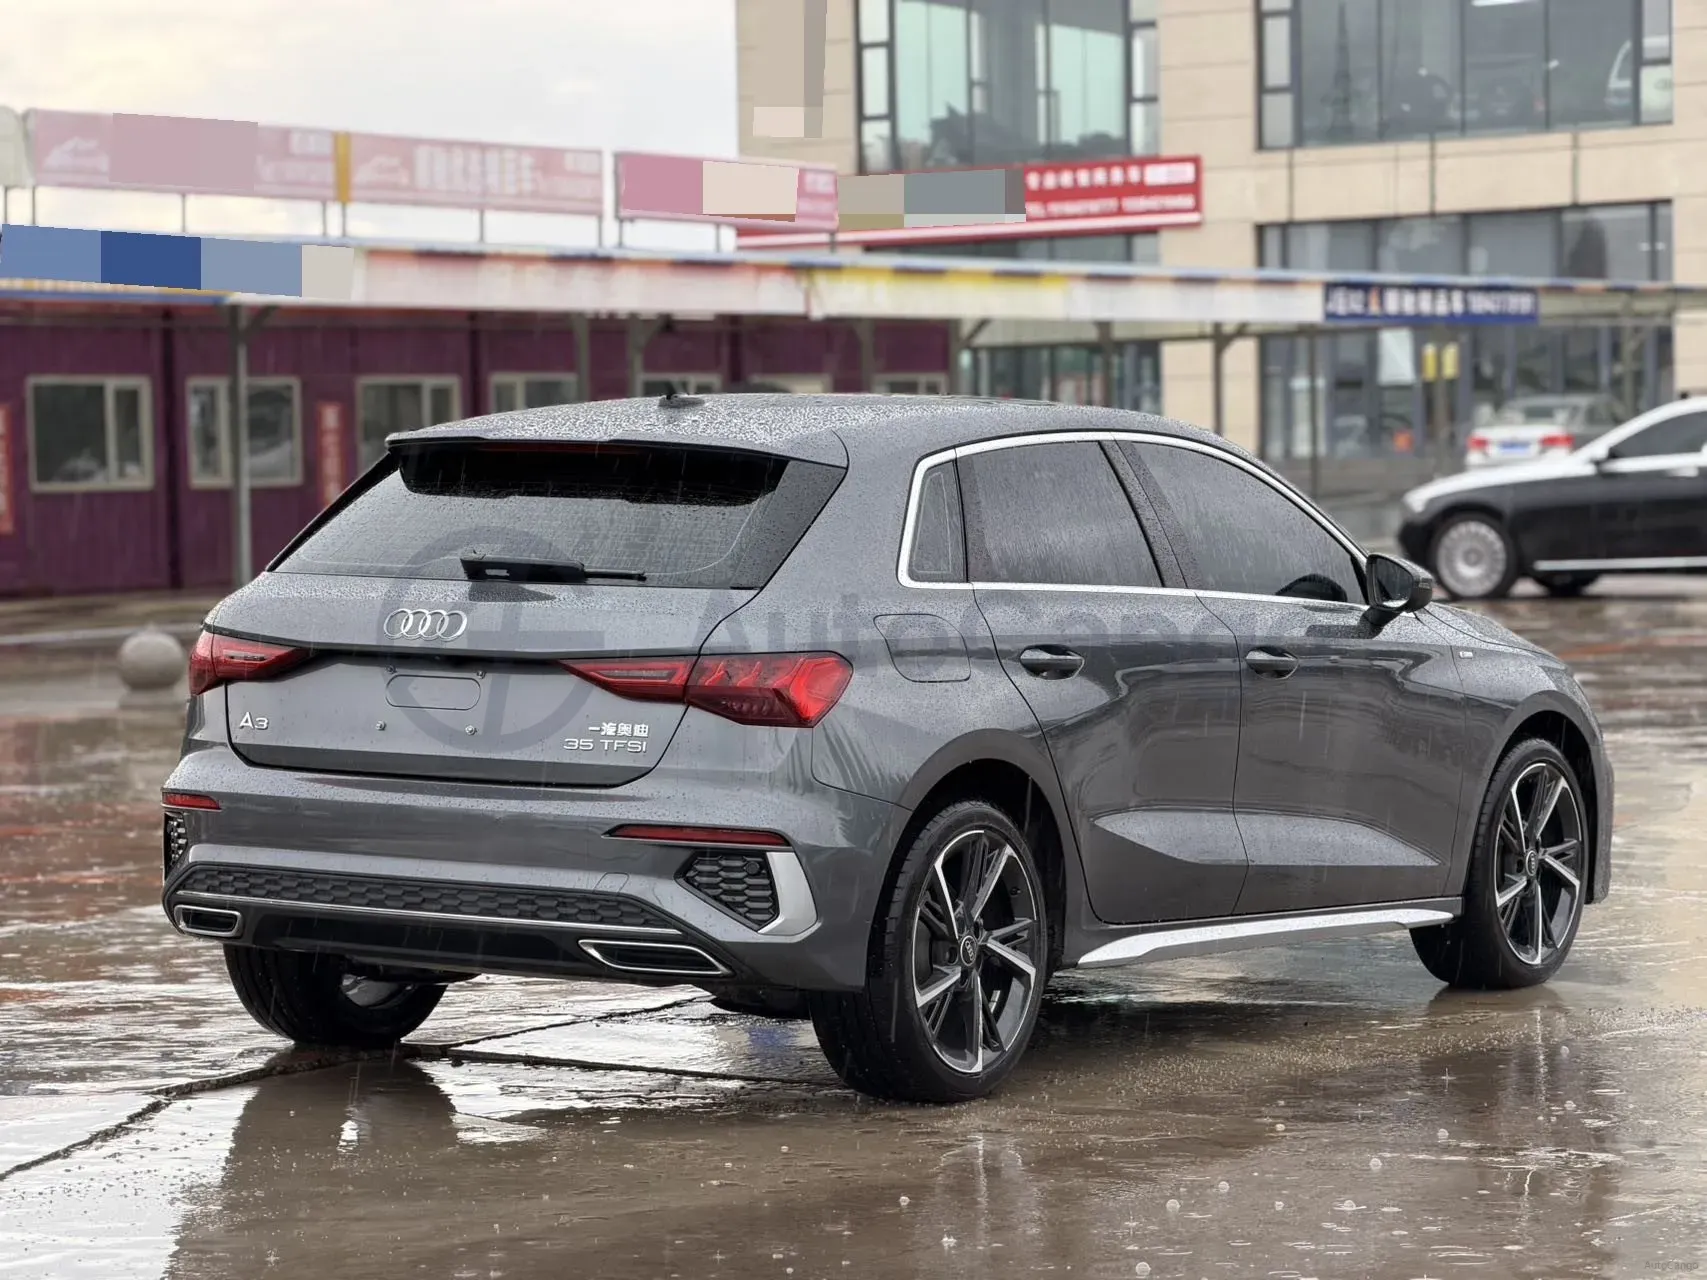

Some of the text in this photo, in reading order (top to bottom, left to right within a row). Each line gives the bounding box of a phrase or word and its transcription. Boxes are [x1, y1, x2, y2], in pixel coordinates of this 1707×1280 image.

[240, 711, 270, 731] A3
[588, 722, 649, 738] 一汽奥迪
[563, 738, 647, 753] 35 TFSI
